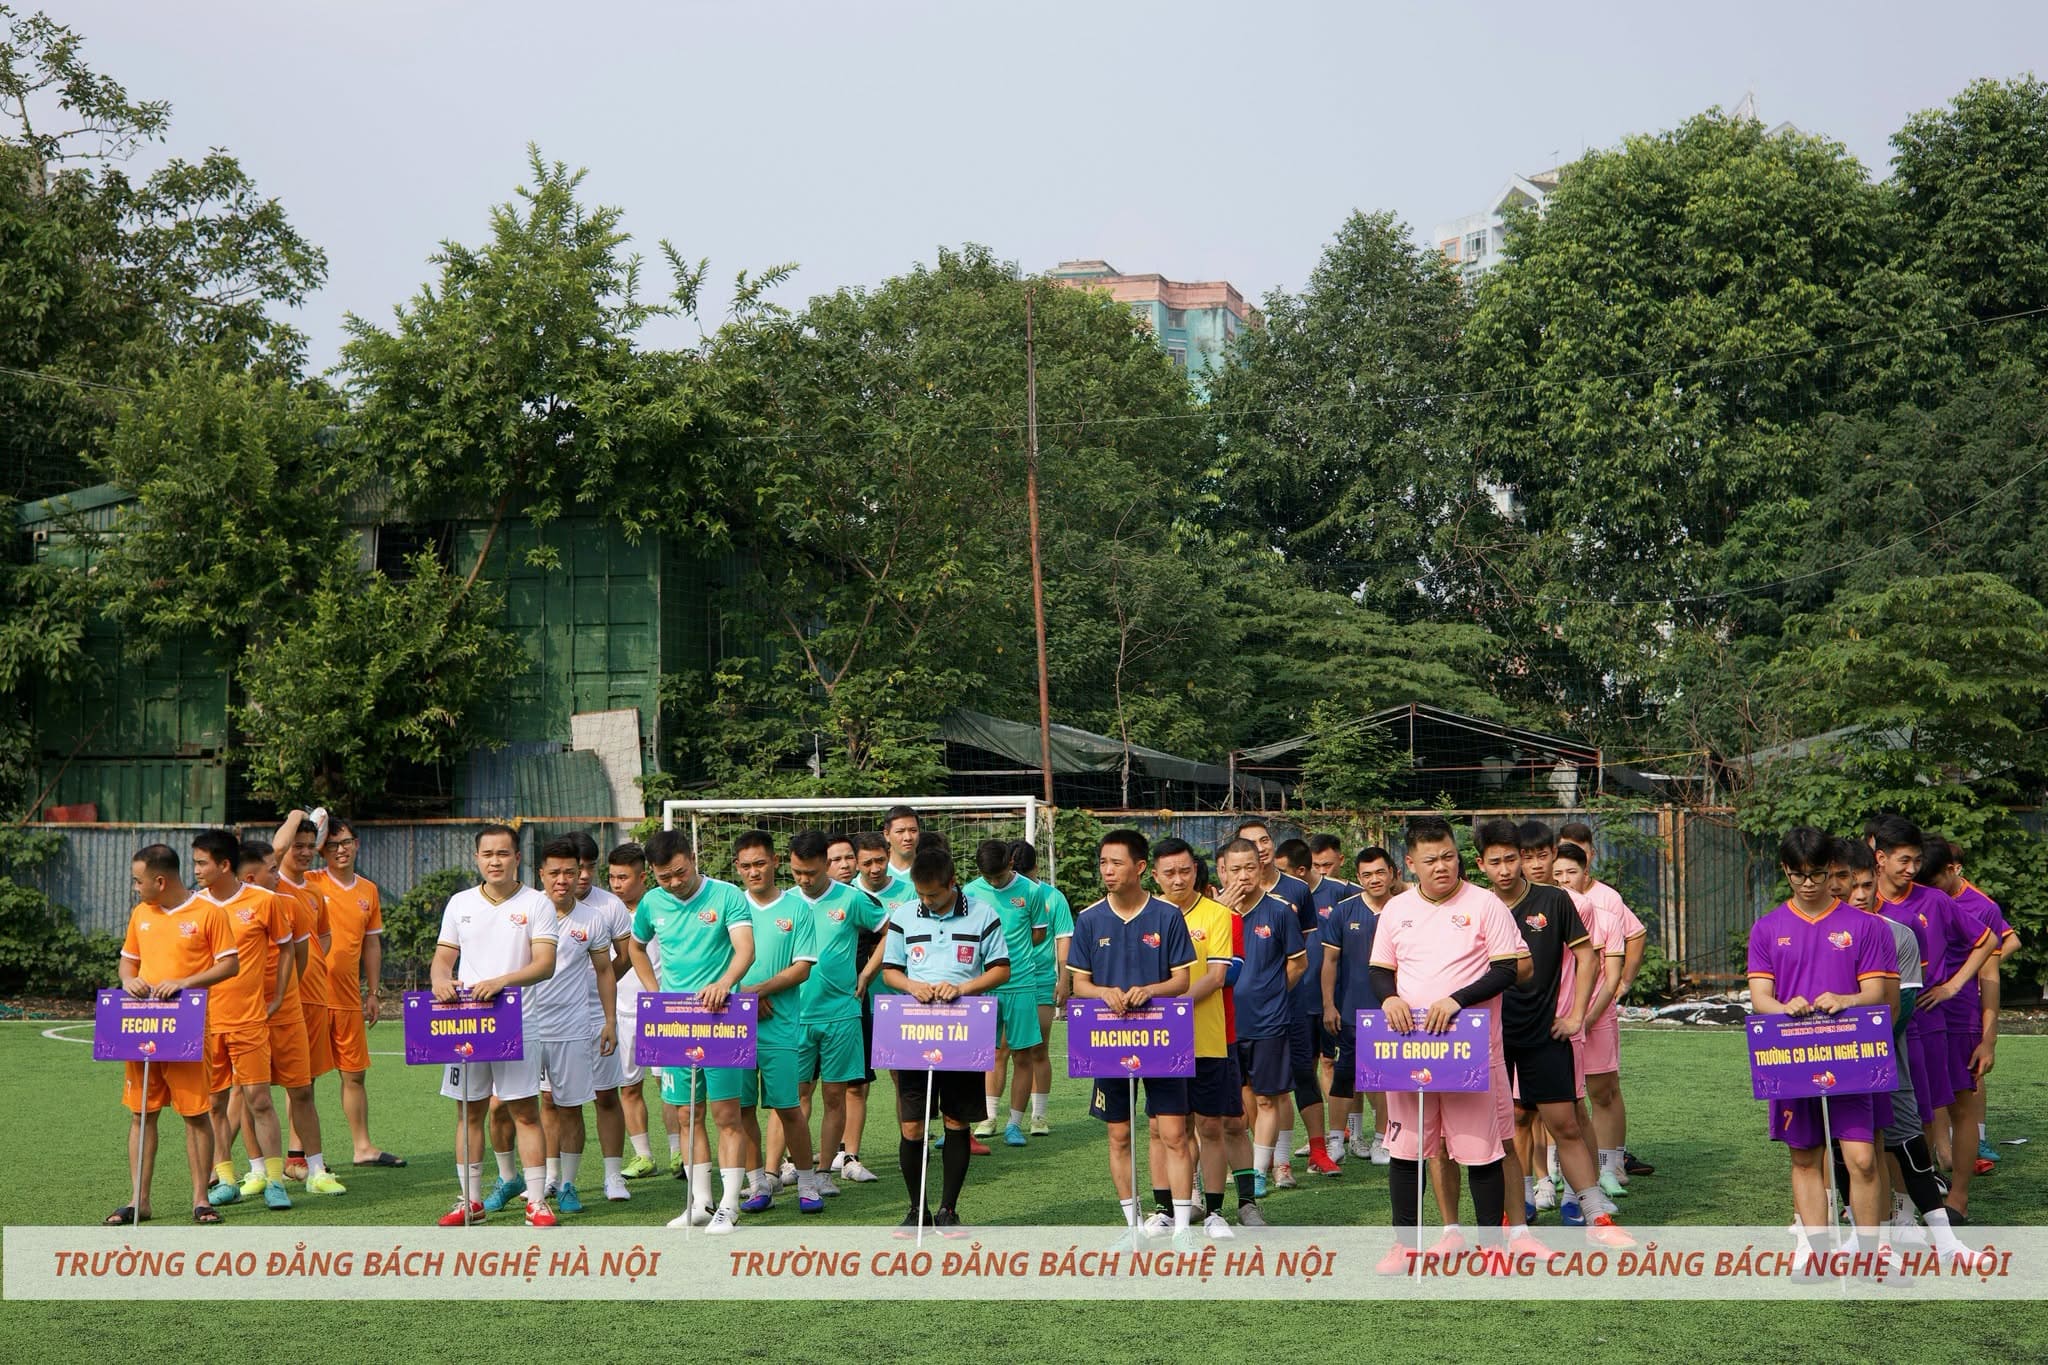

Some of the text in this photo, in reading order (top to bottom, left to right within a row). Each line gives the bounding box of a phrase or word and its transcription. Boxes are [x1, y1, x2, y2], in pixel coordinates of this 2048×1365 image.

[121, 1017, 176, 1034] FECON FC
[430, 1017, 496, 1036] SUNJIN FC
[644, 1021, 748, 1040] CA PHƯỜNG ĐỊNH CÔNG FC
[901, 1022, 968, 1044] TRỌNG TÀI
[1090, 1030, 1170, 1047] HACINCO FC
[1374, 1041, 1471, 1060] TBT GROUP FC
[1754, 1046, 1792, 1066] TRƯỜNG
[1807, 1043, 1833, 1063] BÁCH
[1834, 1041, 1860, 1062] NGHỆ
[1876, 1041, 1888, 1057] FC
[1783, 1110, 1793, 1131] 7
